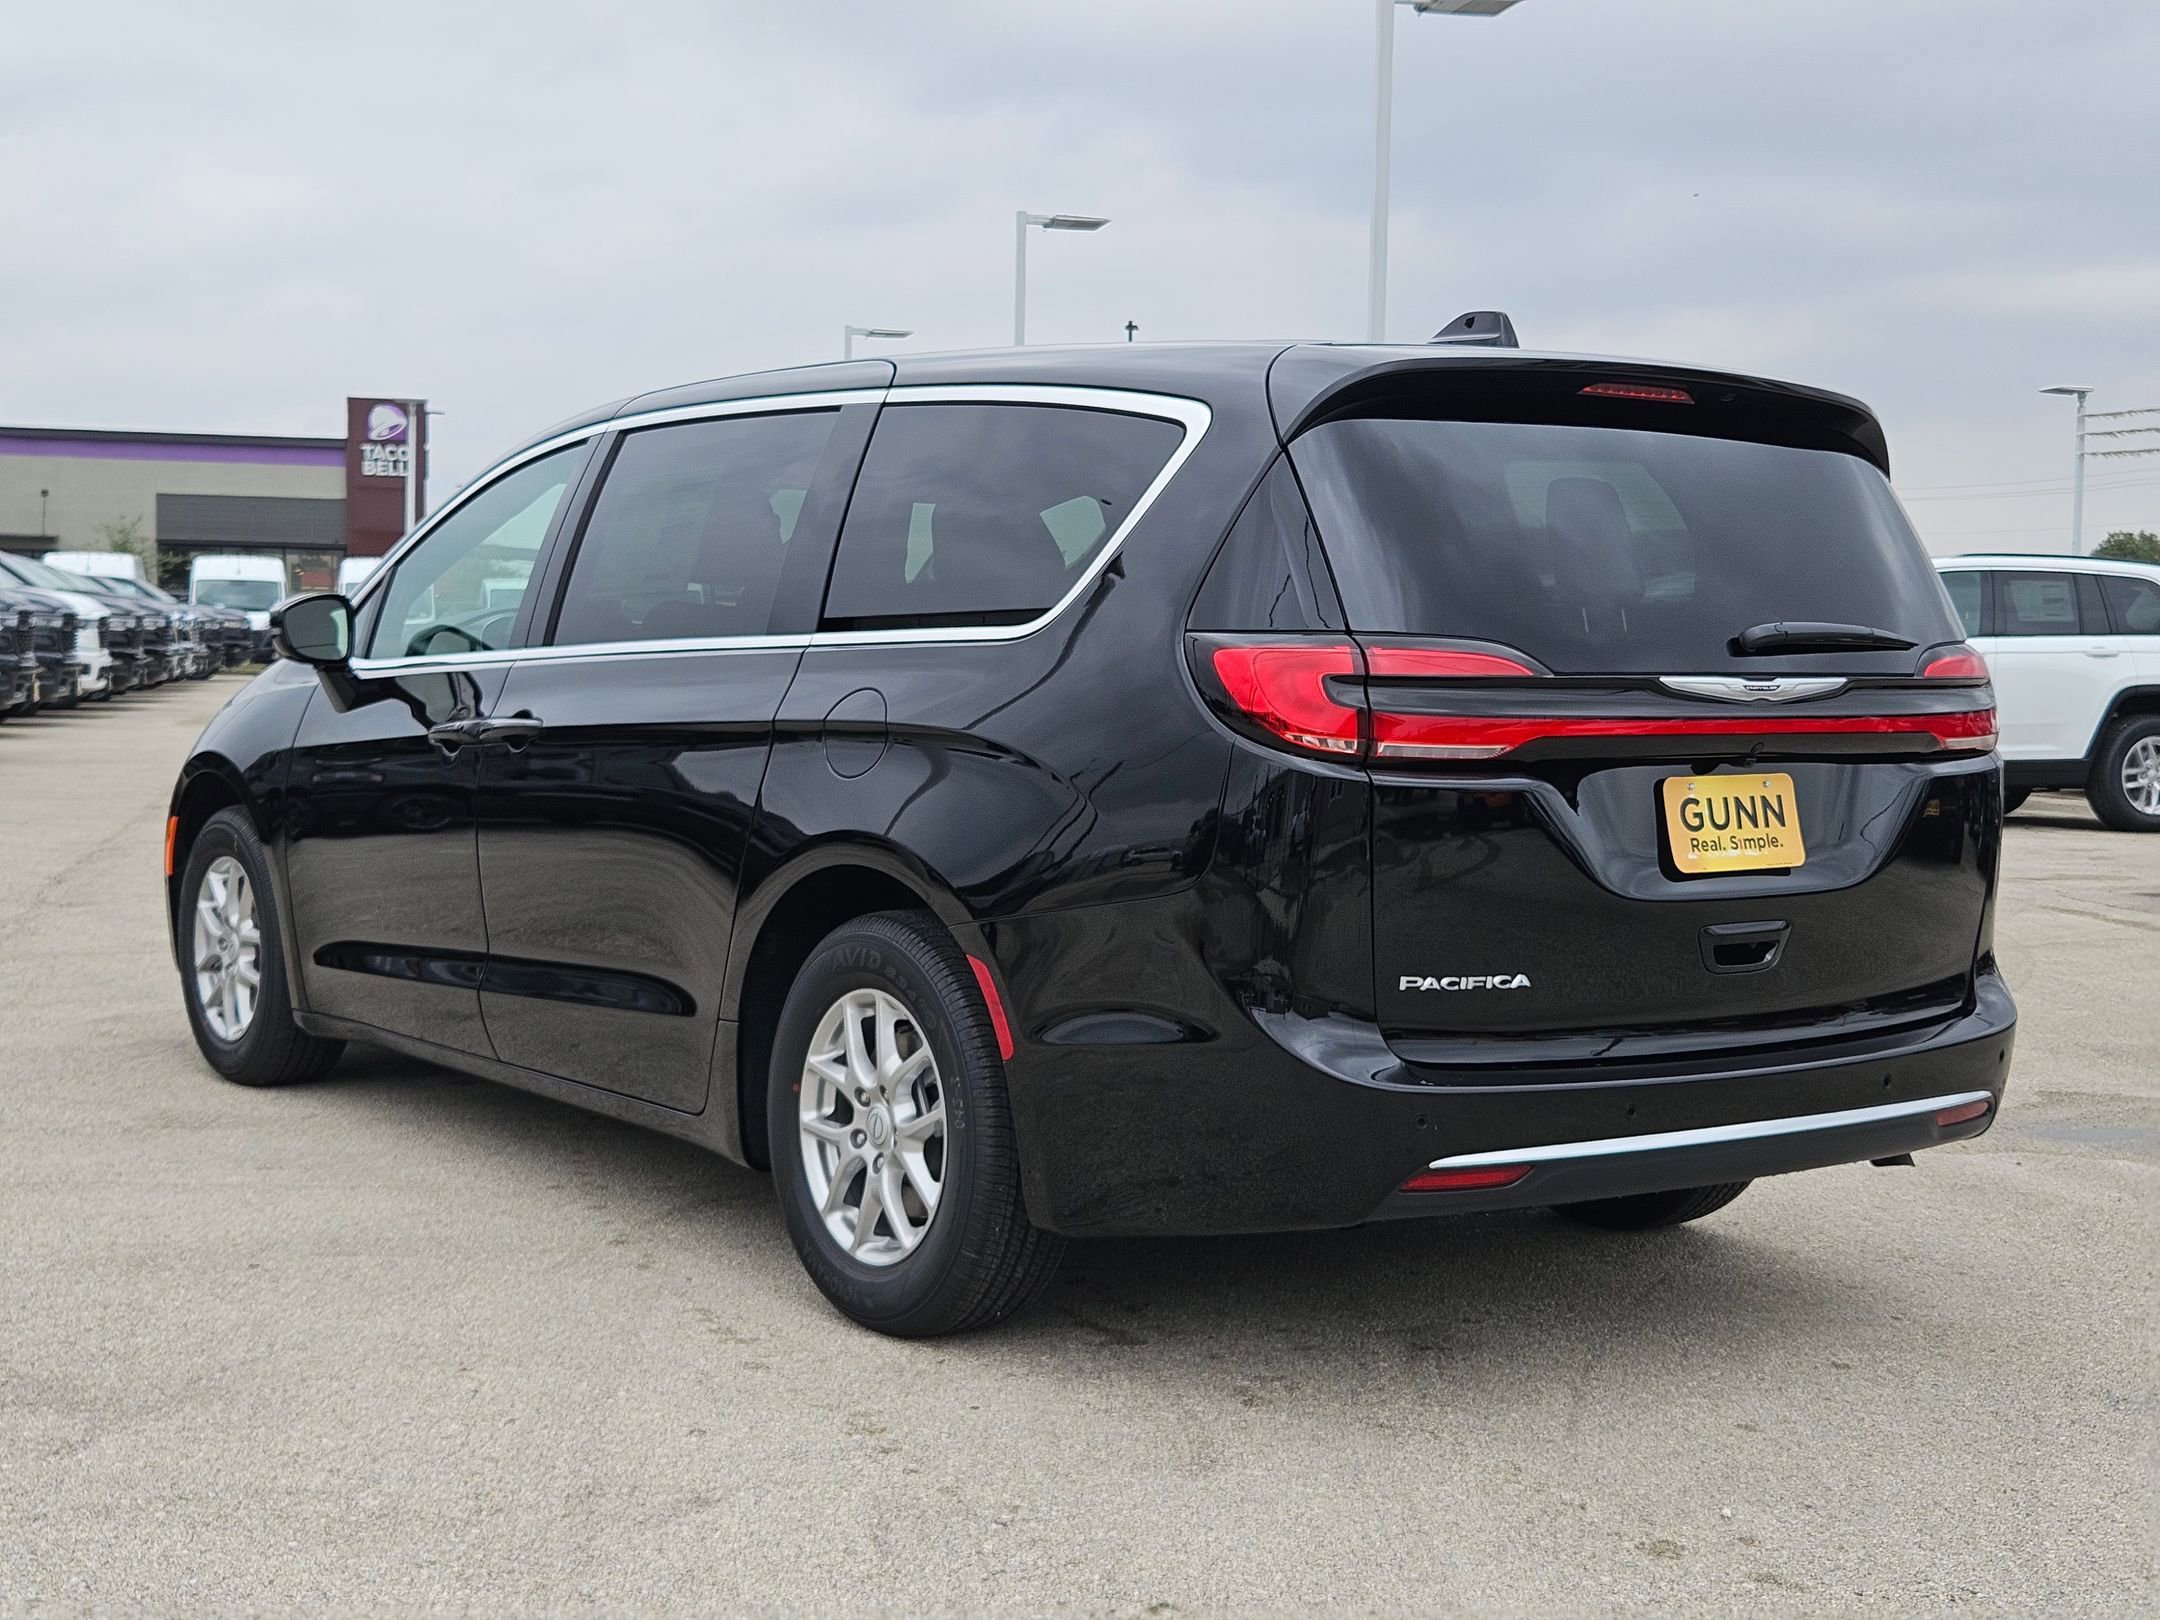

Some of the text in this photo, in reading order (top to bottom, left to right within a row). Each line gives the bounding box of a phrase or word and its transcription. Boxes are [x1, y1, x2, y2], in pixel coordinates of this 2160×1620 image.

[360, 443, 408, 460] TACO
[361, 461, 408, 476] BELL
[1679, 794, 1786, 832] GUNN
[1690, 837, 1726, 853] Real.
[1399, 974, 1532, 991] PACIFICA
